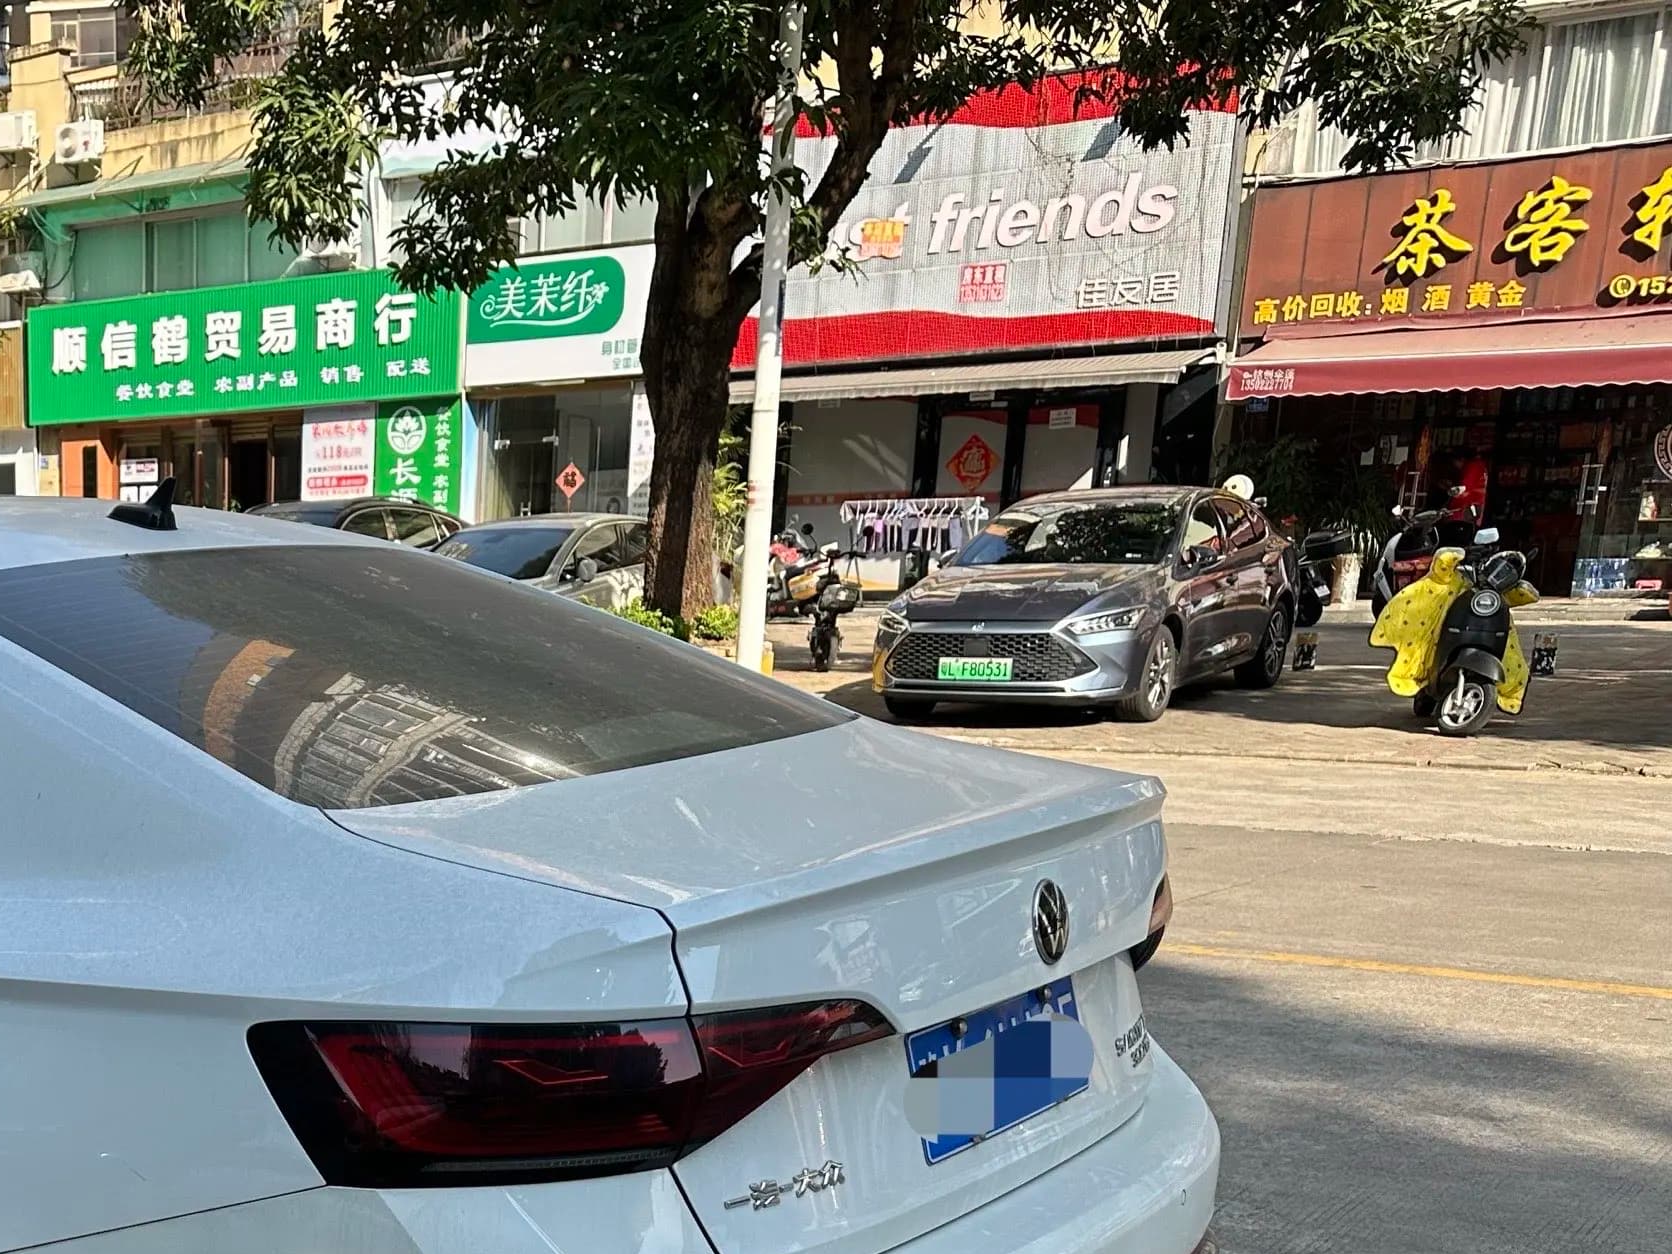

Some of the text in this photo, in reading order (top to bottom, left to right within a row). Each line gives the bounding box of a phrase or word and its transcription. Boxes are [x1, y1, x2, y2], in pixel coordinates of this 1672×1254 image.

[928, 172, 1178, 255] friends
[492, 268, 596, 322] 美茉纤
[1076, 271, 1180, 309] 佳友居
[1380, 287, 1409, 314] 烟
[1422, 284, 1452, 312] 酒
[1466, 279, 1527, 309] 黄金
[51, 292, 418, 375] 顺信鹤贸易商行
[115, 356, 431, 402] 餐饮食堂 农副产品 销售 配送
